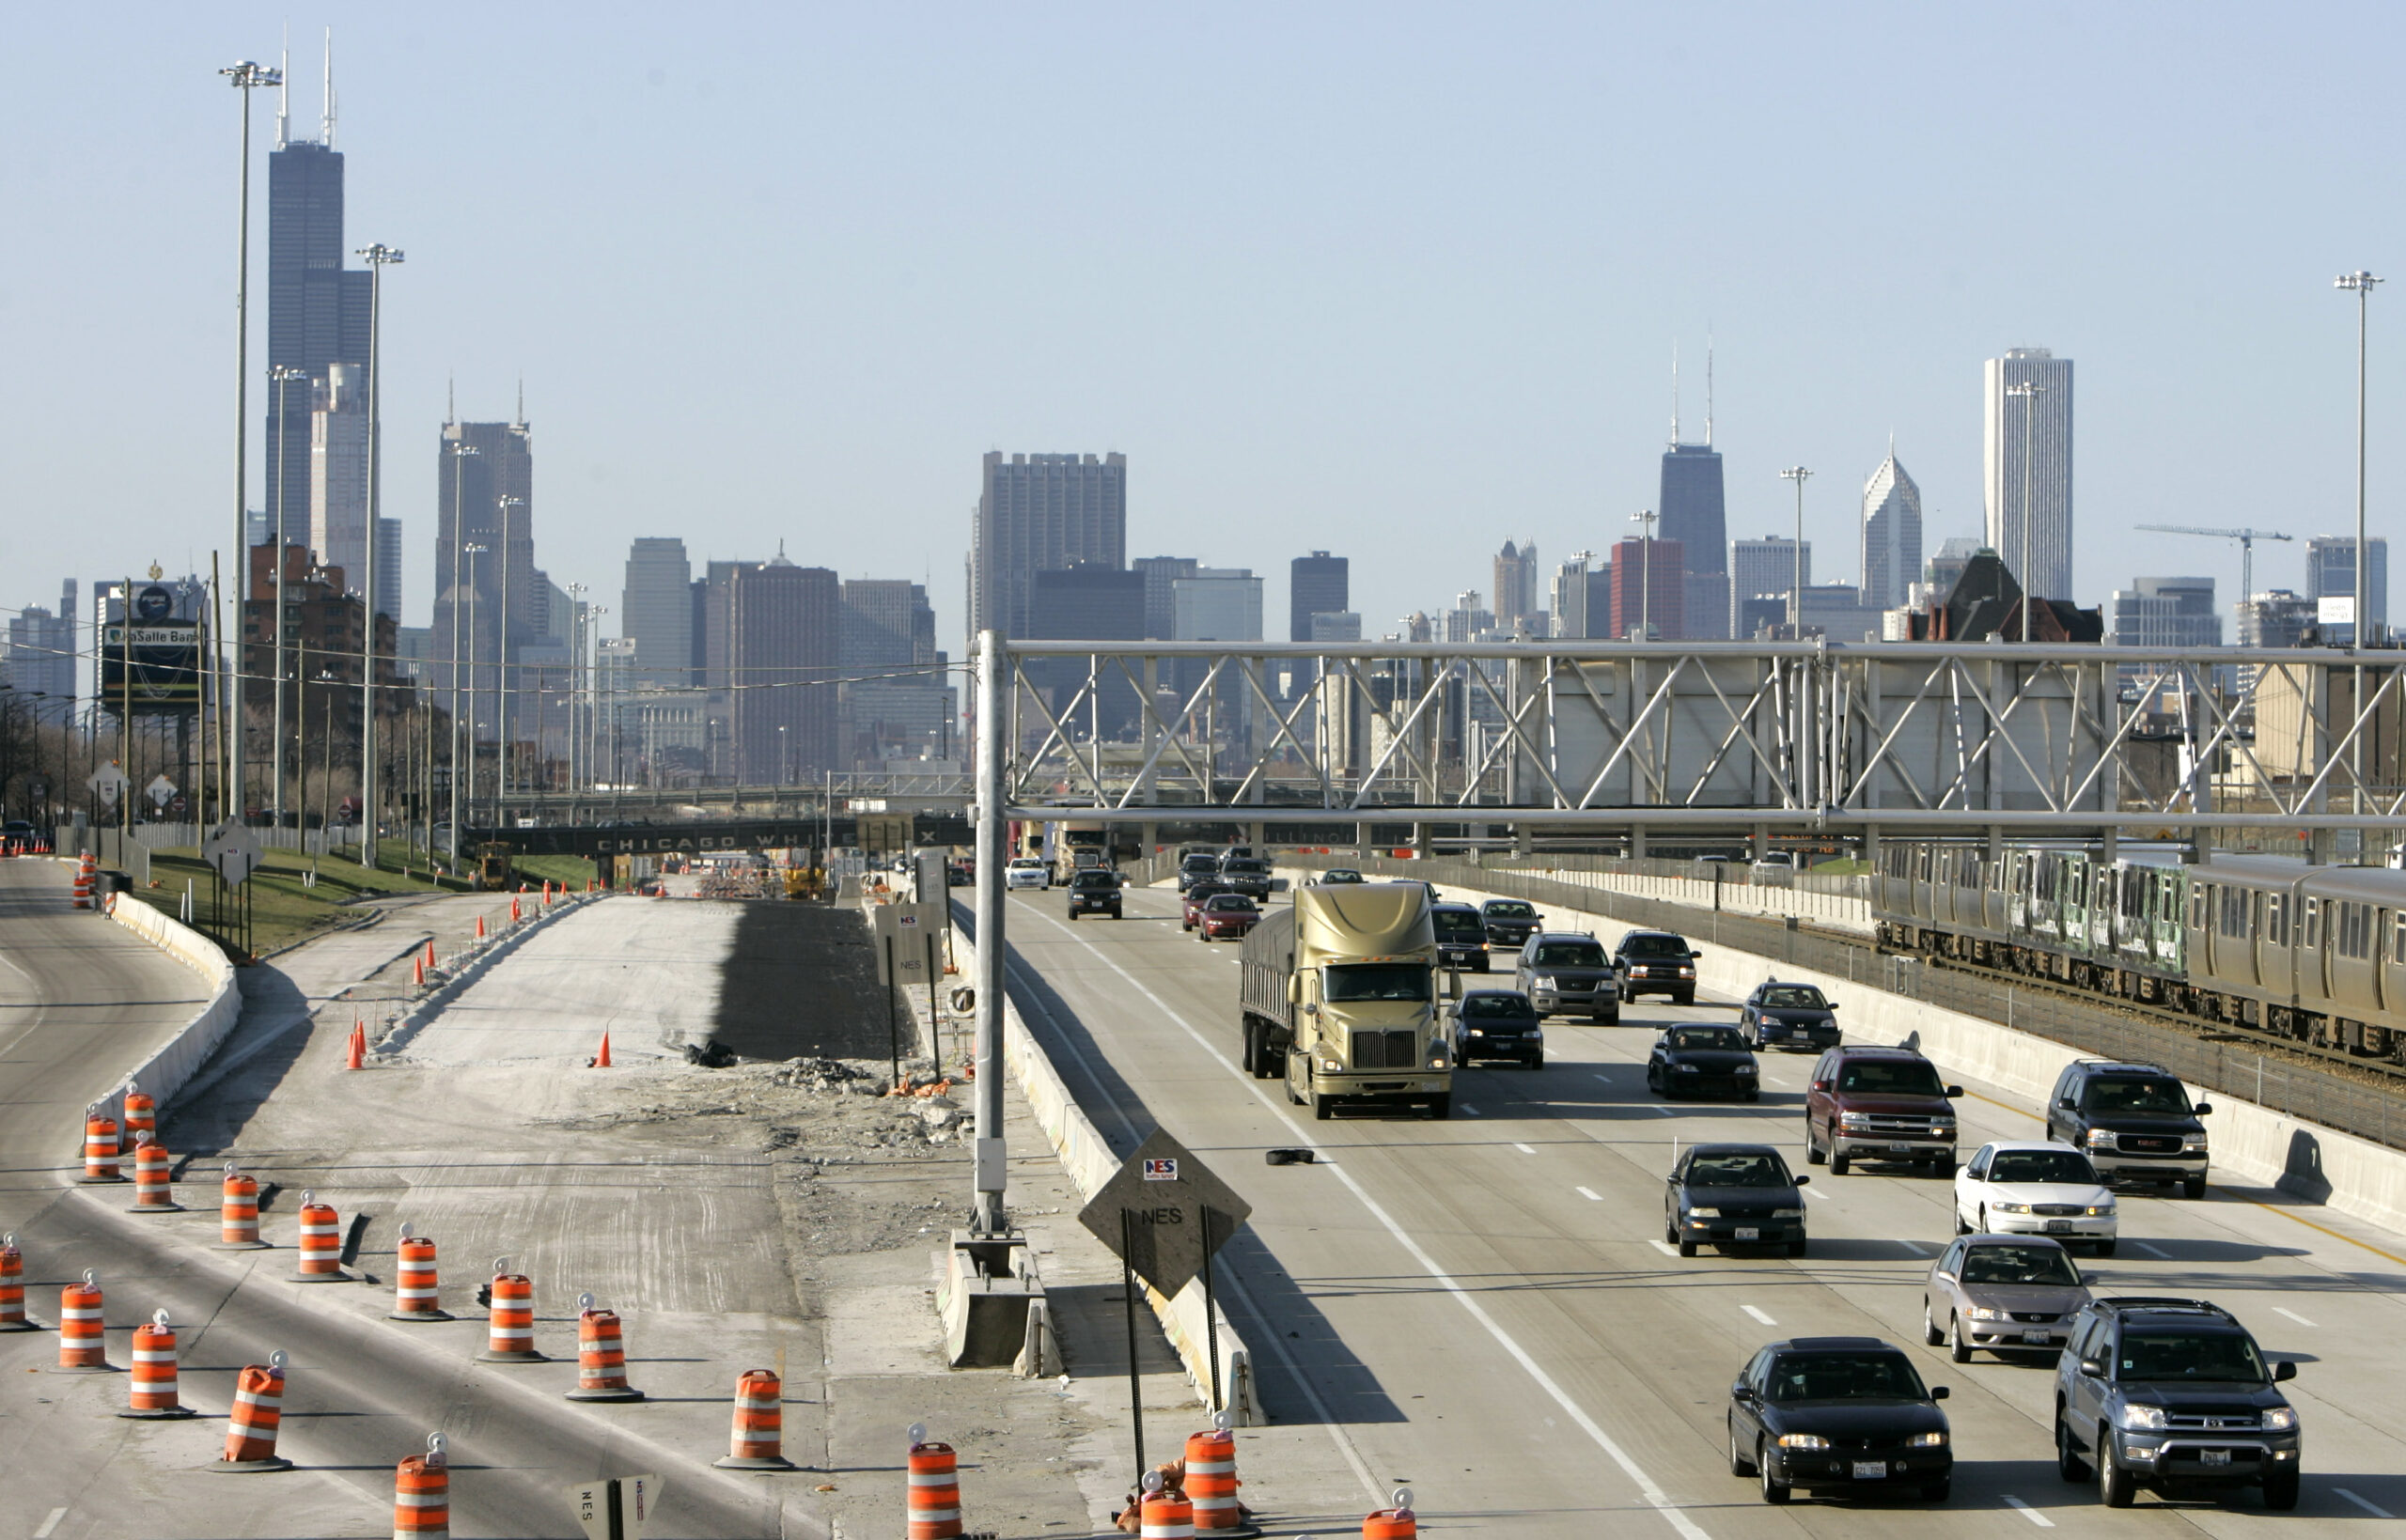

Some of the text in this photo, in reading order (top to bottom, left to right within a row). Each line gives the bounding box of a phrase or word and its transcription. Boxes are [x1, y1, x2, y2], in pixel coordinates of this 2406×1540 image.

[122, 630, 167, 643] aSalle
[598, 832, 856, 850] CHICAGO WHITE
[1265, 832, 1351, 844] ILLINOI
[900, 916, 916, 925] NES
[900, 960, 922, 970] NES
[1146, 1159, 1175, 1173] NES
[1142, 1208, 1182, 1225] NES
[582, 1491, 592, 1520] NES
